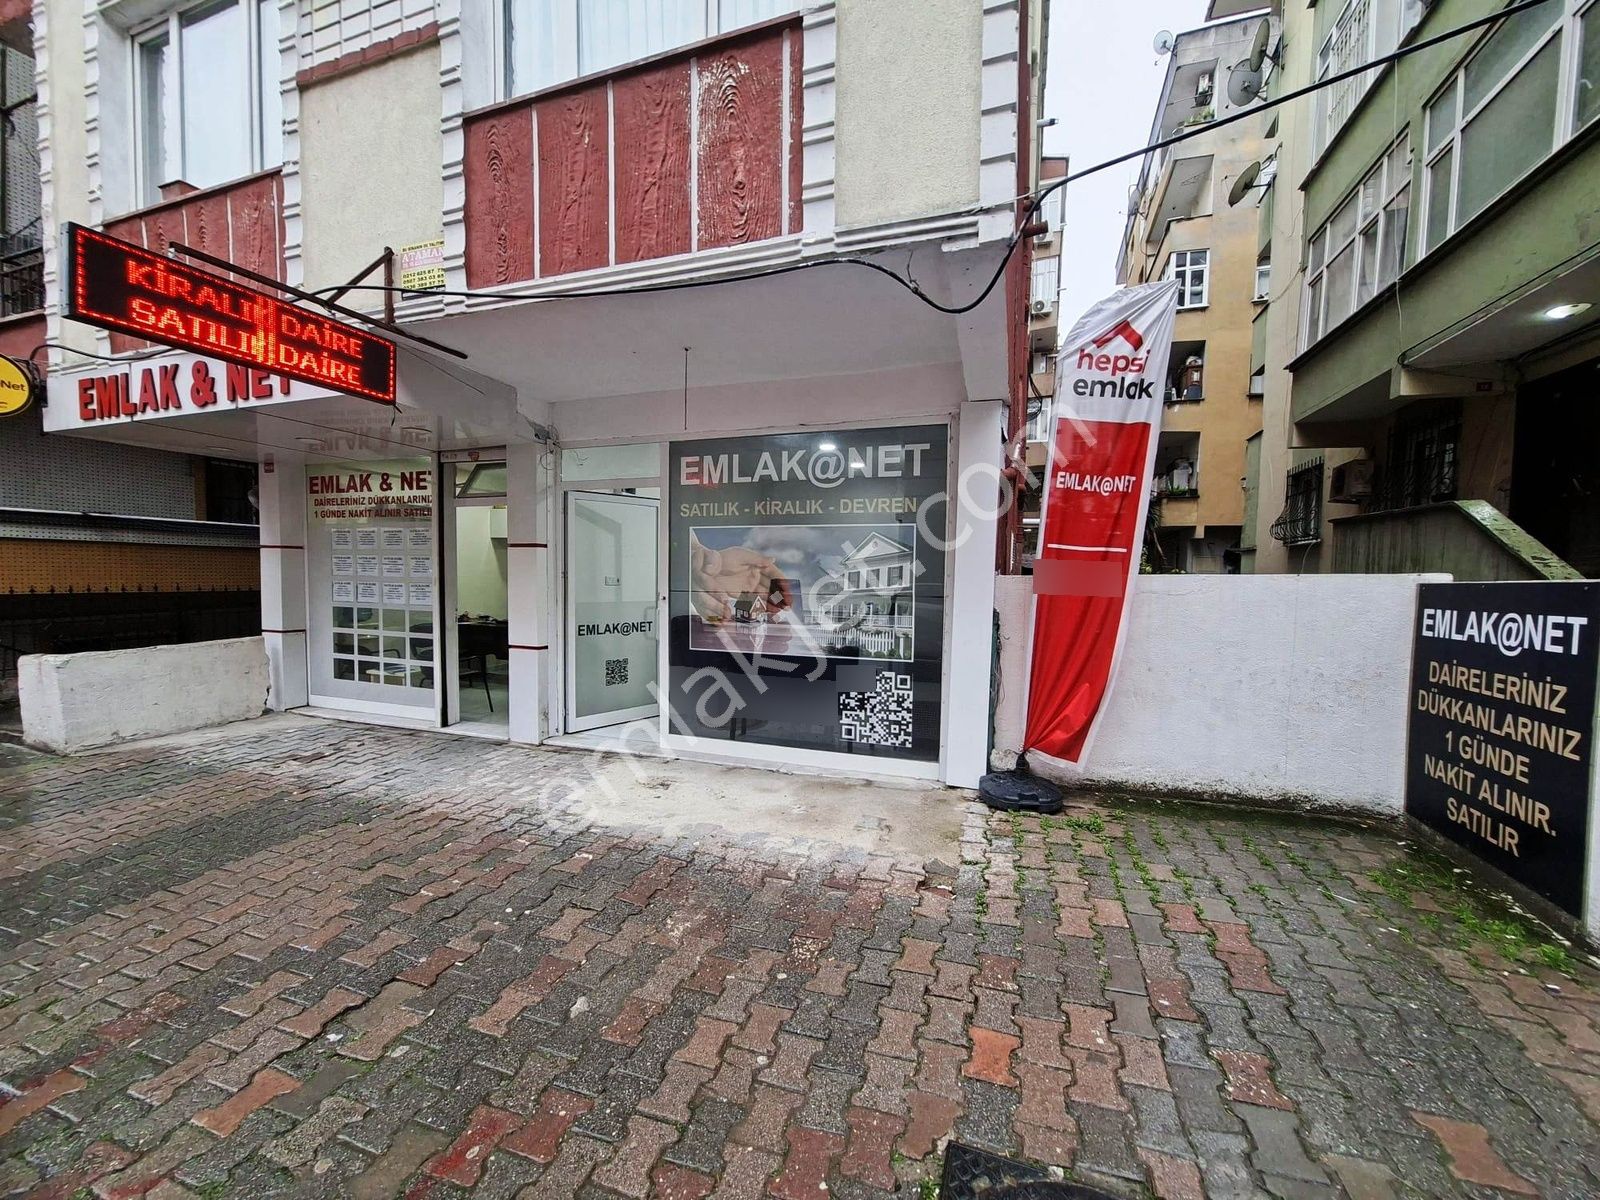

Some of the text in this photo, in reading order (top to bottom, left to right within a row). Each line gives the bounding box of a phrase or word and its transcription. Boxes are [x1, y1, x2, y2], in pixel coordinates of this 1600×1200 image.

[281, 313, 363, 360] DAİRE
[279, 343, 361, 386] DAİRE
[1076, 348, 1150, 377] hepsi
[78, 363, 182, 421] EMLAK
[190, 360, 217, 408] &
[1073, 376, 1155, 400] emlak
[309, 473, 373, 494] EMLAK
[379, 472, 393, 492] &
[680, 443, 931, 489] EMLAK@NET
[1055, 470, 1137, 497] EMLAK@NET
[314, 495, 366, 507] DAİRELERİNİZ
[320, 508, 346, 519] GÜNDE
[348, 508, 372, 518] NAKİT
[680, 501, 739, 518] SATILIK
[754, 497, 823, 516] KİRALIK
[839, 497, 917, 515] DEVREN
[577, 621, 653, 637] EMLAK@NET
[1421, 608, 1588, 657] EMLAK@NET
[1428, 659, 1568, 715] DAİRELERİNİZ
[1418, 688, 1582, 761] DÜKKANLARINIZ
[1444, 731, 1530, 785] 1 GÜNDE
[1424, 753, 1557, 837] NAKİT ALINIR.
[1446, 796, 1520, 858] SATILIR
